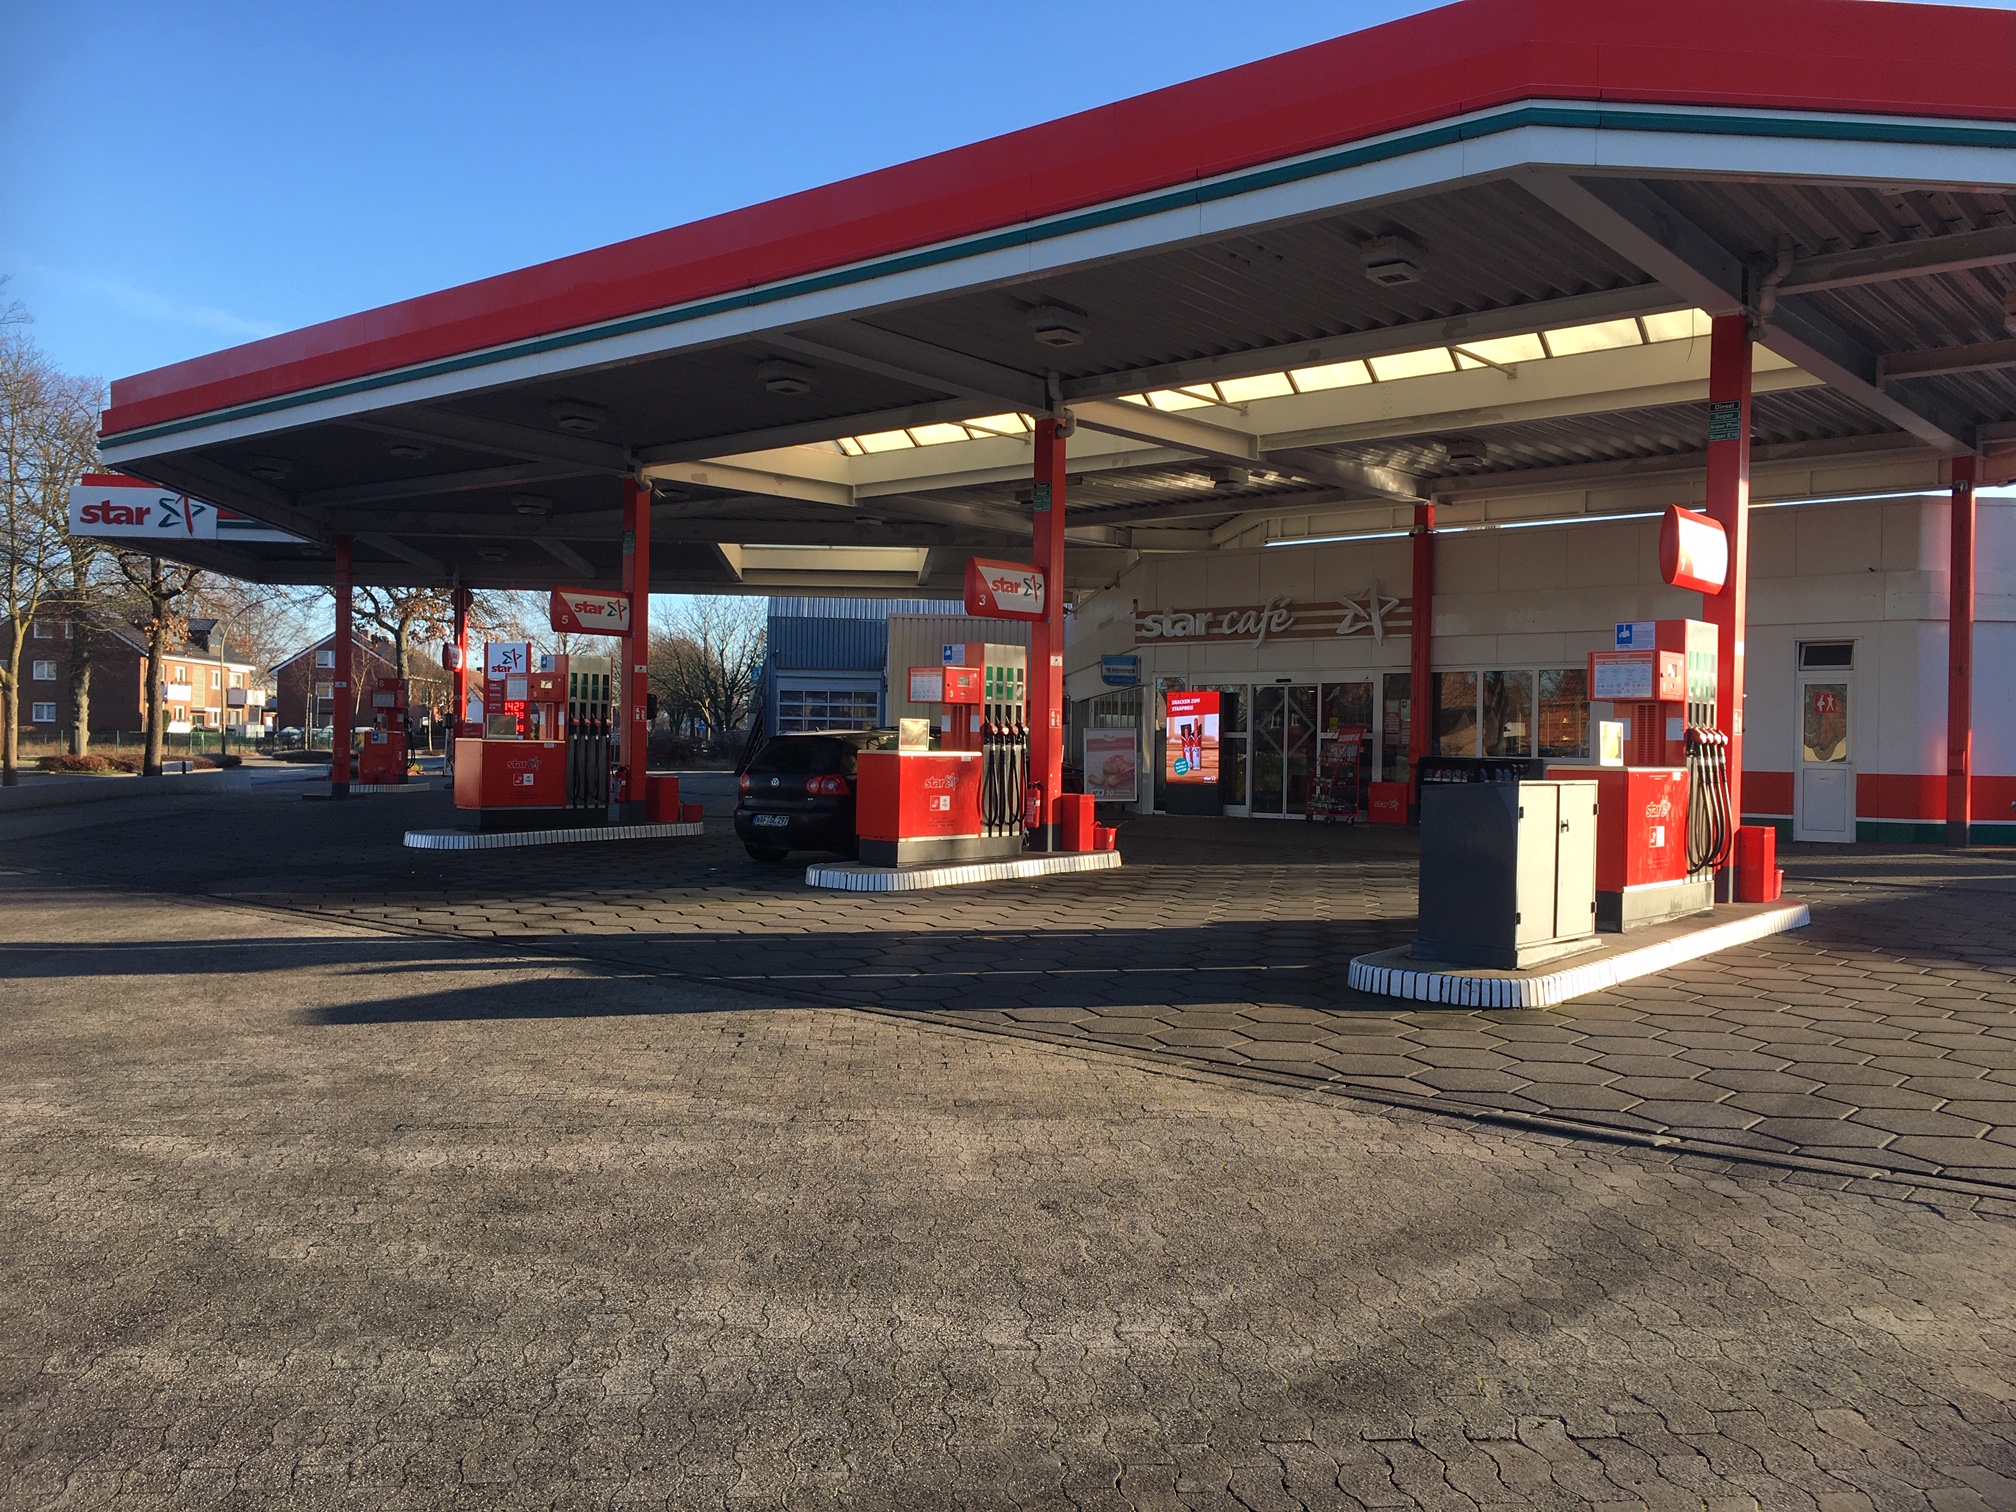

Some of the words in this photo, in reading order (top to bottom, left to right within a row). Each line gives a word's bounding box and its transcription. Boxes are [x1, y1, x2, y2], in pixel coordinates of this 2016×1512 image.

[80, 500, 151, 525] star
[1681, 556, 1687, 572] 1
[992, 576, 1021, 594] star
[574, 600, 605, 615] star
[978, 594, 986, 606] 3
[562, 614, 569, 624] 5
[1141, 606, 1216, 638] star
[1222, 595, 1296, 649] café
[491, 664, 512, 672] star
[507, 759, 527, 769] star
[925, 776, 945, 788] star
[1646, 801, 1661, 817] star
